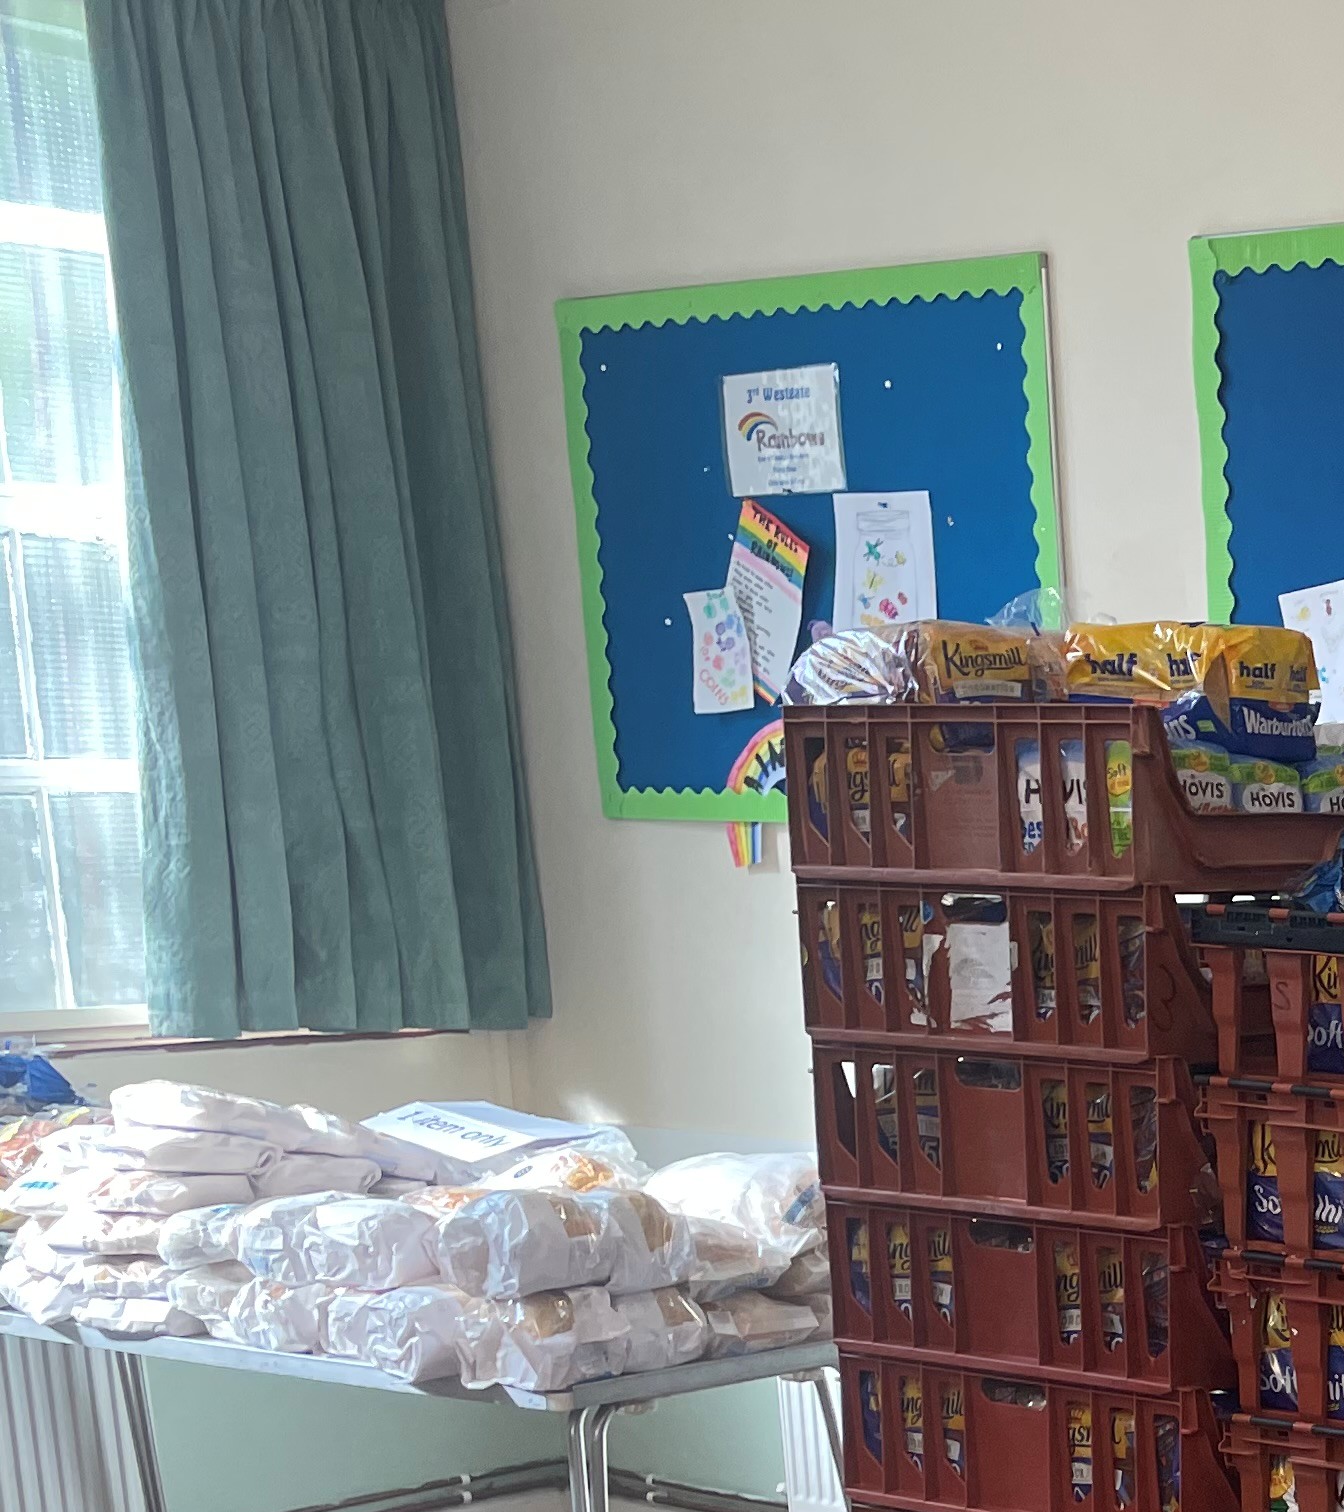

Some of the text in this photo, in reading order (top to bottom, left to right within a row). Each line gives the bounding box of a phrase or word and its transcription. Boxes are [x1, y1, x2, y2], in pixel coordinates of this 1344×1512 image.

[942, 639, 1028, 680] Kingsmill
[1239, 661, 1276, 683] half
[1250, 792, 1296, 811] HOVIS
[412, 1115, 465, 1134] item
[461, 1131, 511, 1148] only
